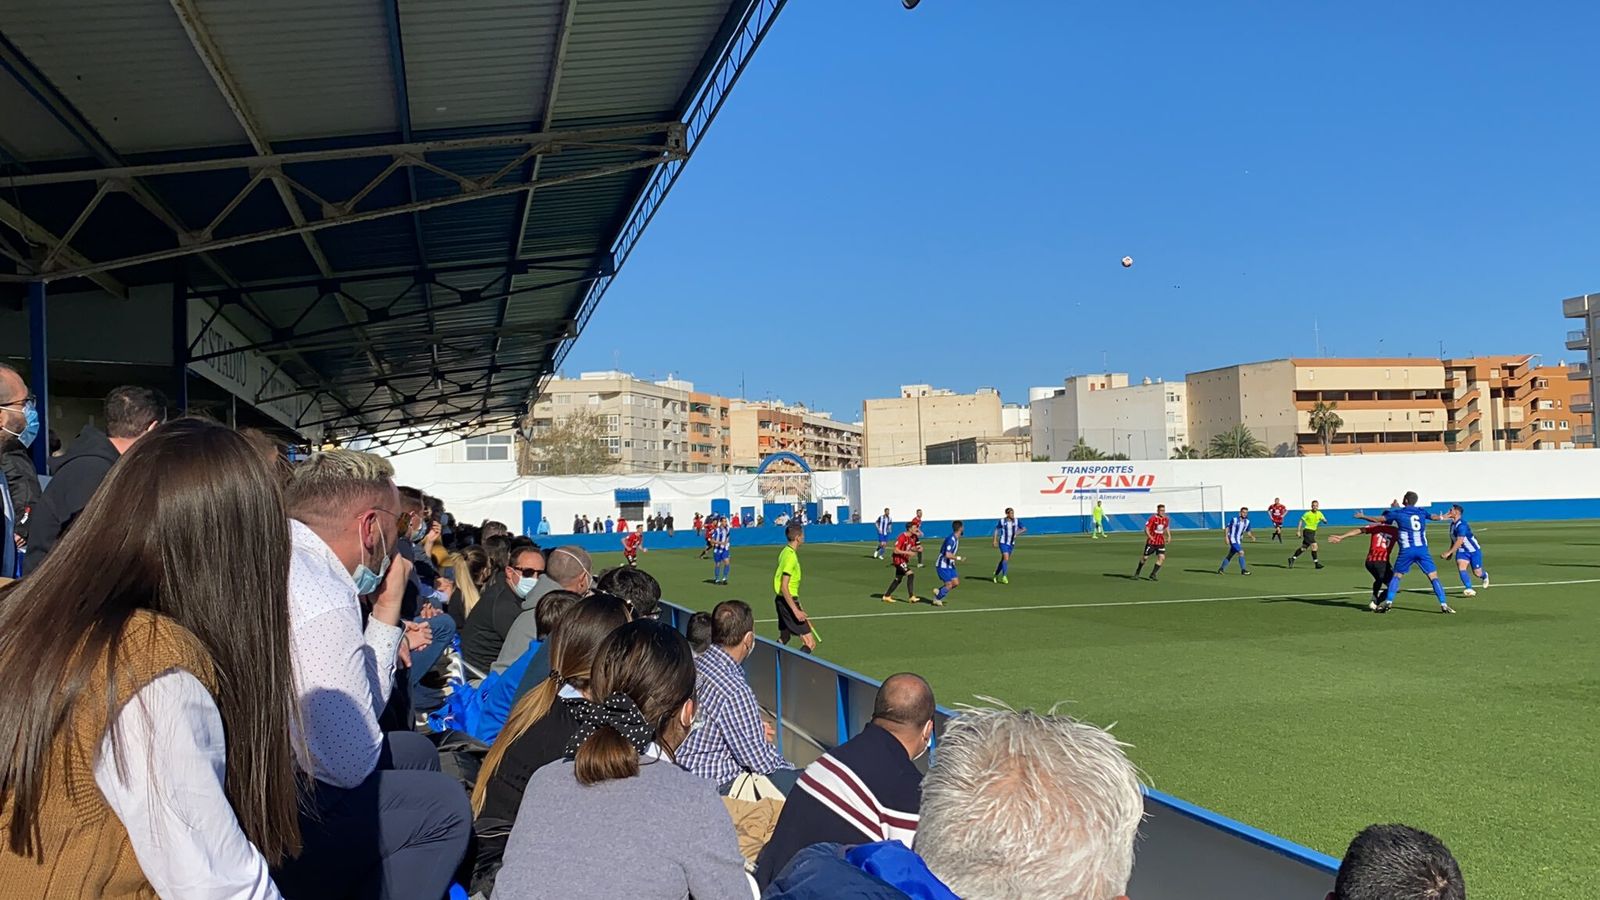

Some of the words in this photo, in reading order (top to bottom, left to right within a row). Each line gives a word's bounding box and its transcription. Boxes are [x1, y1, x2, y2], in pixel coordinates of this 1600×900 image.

[1061, 465, 1134, 474] TRANSPORTES
[1410, 514, 1422, 531] 6
[1376, 532, 1392, 549] 15
